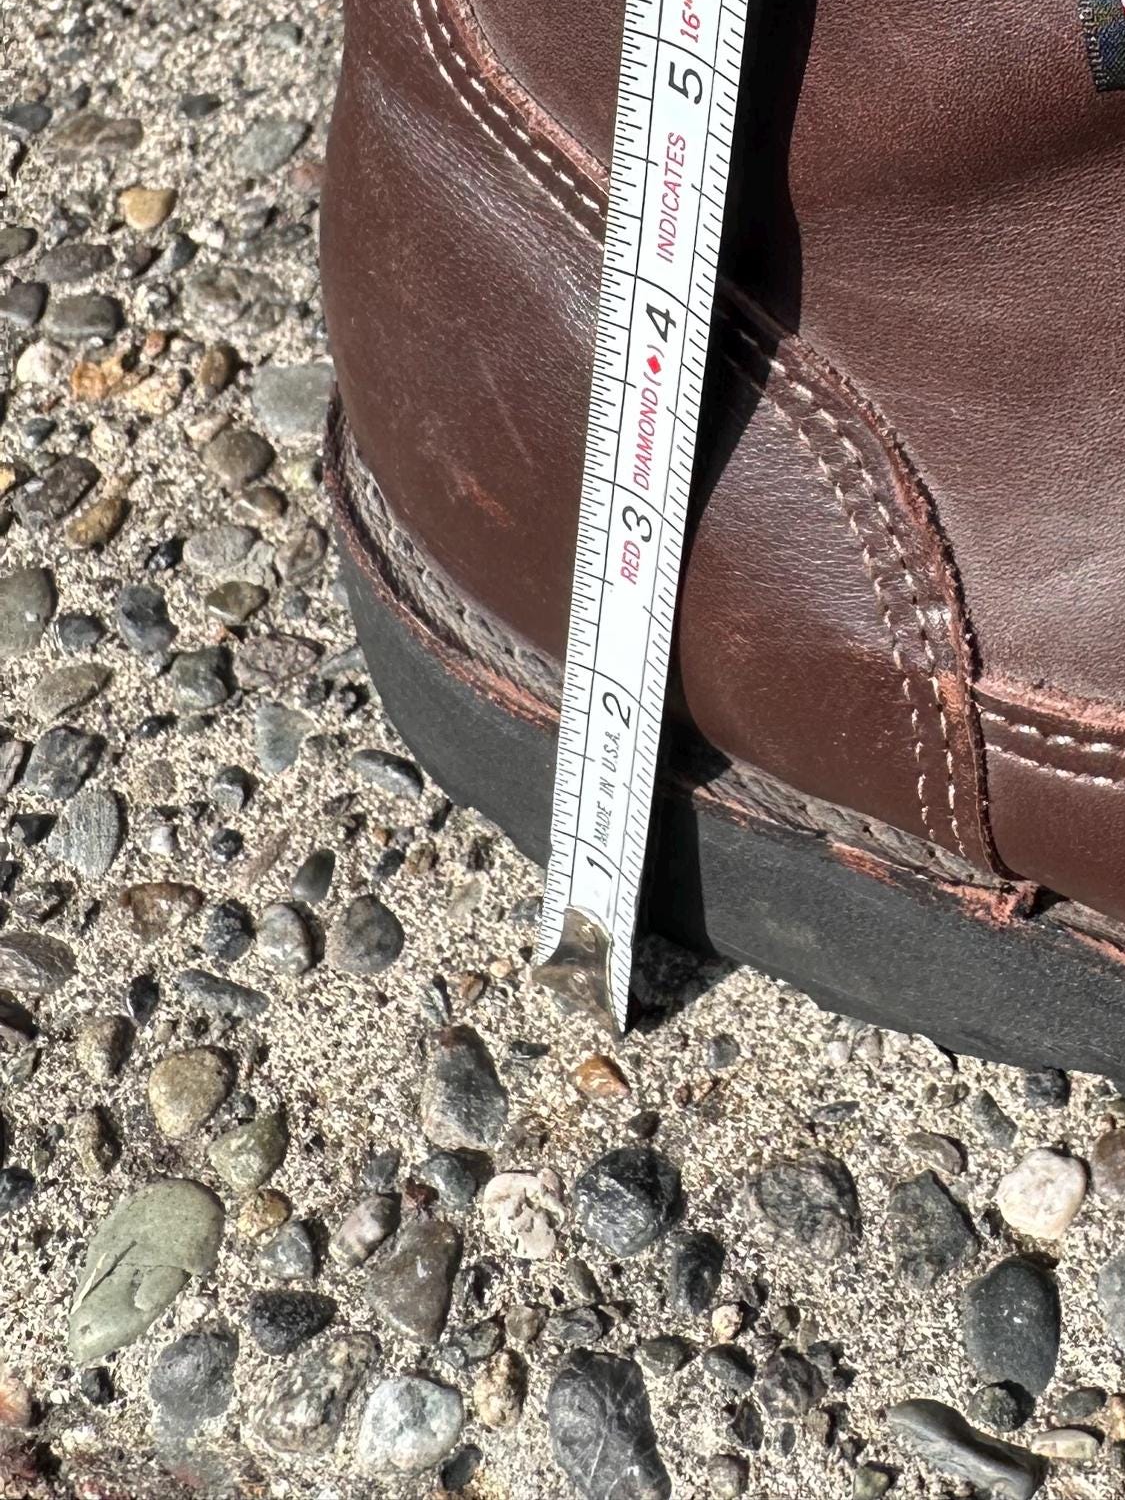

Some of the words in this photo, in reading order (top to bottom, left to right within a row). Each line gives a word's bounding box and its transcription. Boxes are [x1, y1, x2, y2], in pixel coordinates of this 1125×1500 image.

[668, 61, 703, 105] 5
[646, 302, 677, 343] 4
[620, 540, 641, 585] RED
[656, 132, 686, 263] INDICATES
[622, 505, 652, 543] 3
[602, 691, 631, 729] 2
[599, 776, 615, 799] IN
[593, 800, 612, 847] MADE
[586, 856, 612, 880] 1
